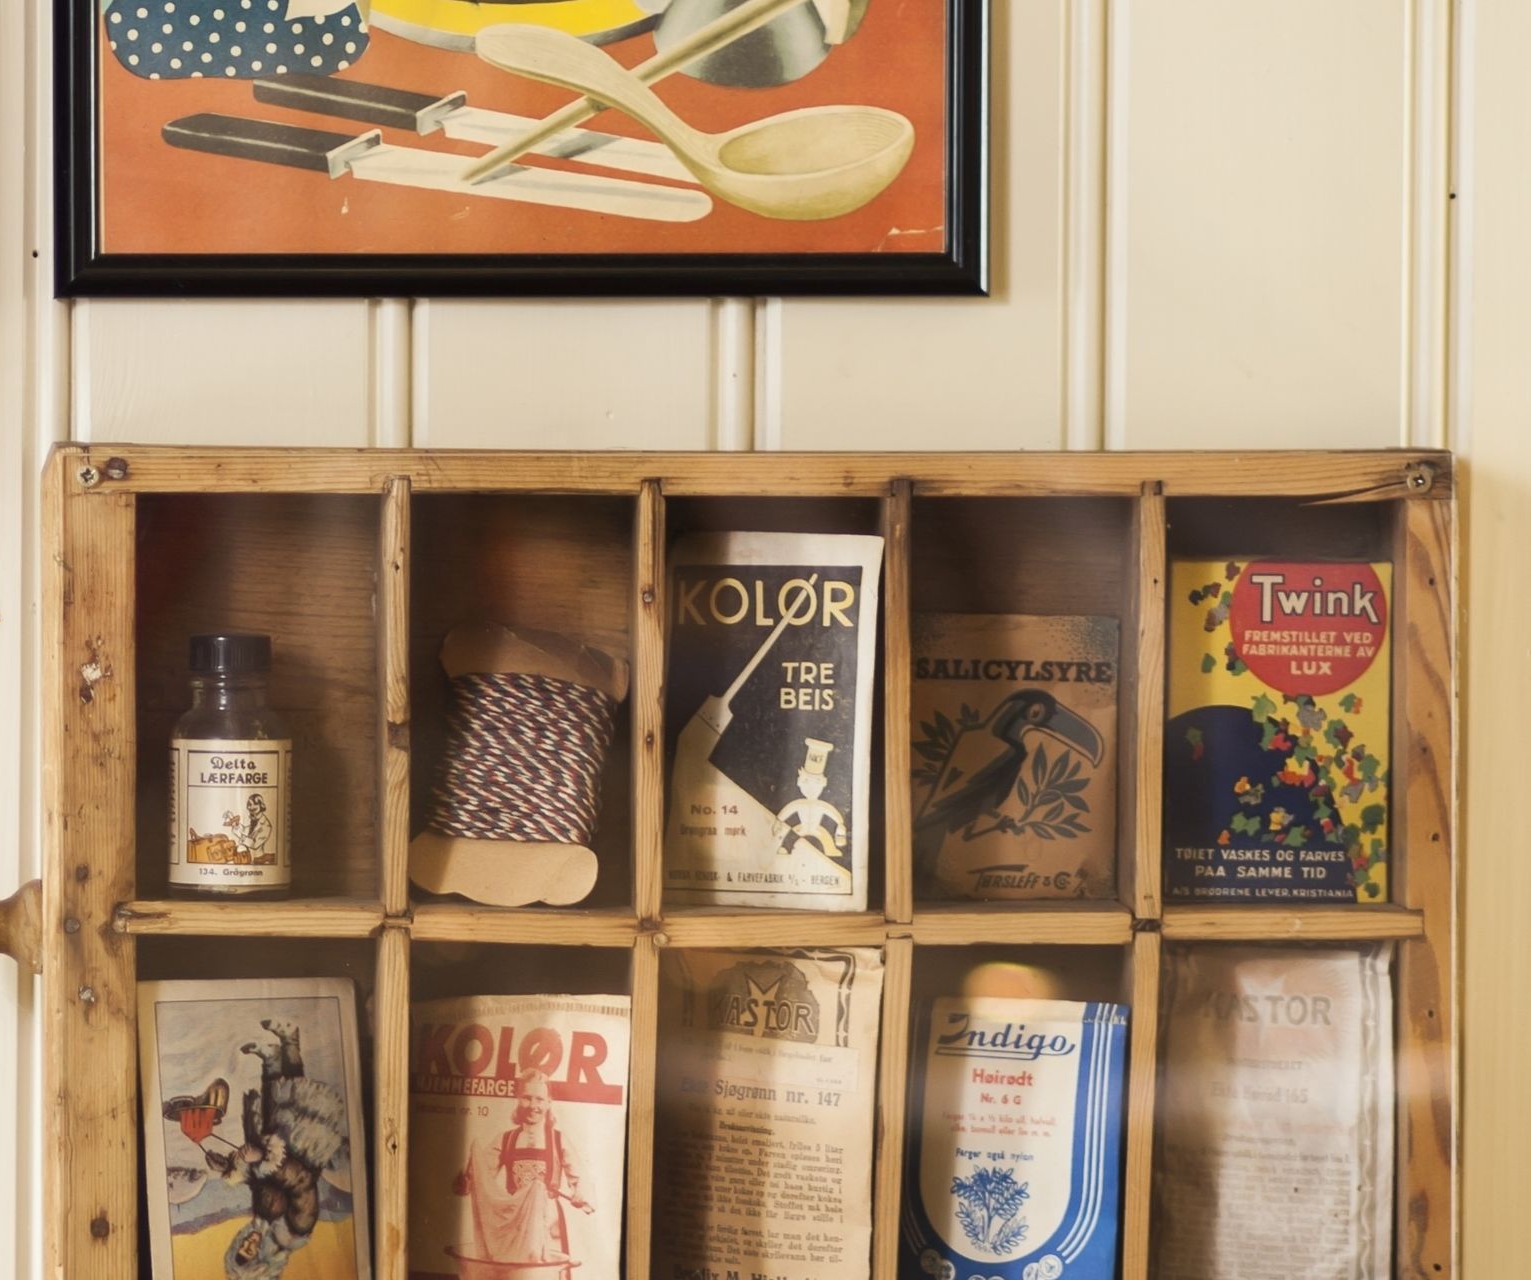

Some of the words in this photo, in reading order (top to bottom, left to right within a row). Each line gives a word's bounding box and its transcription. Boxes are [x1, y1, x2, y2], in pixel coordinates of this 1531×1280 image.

[677, 575, 856, 628] KOLØR
[1249, 573, 1380, 625] Twink
[1243, 630, 1338, 645] FREMSTILLET
[1343, 631, 1373, 644] VED
[1241, 644, 1352, 658] FABRIKANTERNE
[1356, 645, 1375, 658] AV
[780, 661, 835, 686] TRE
[915, 655, 1114, 683] SALICYLSYRE
[1290, 661, 1333, 677] LUX
[779, 687, 835, 711] BEIS
[210, 756, 257, 771] Delta
[200, 772, 268, 785] LÆRFARGE
[690, 804, 717, 816] No.
[721, 804, 740, 816] 14
[1220, 848, 1271, 861] VASKES
[1275, 849, 1295, 861] OG
[1298, 849, 1346, 862] FARVES
[810, 874, 840, 886] BERGEN
[1194, 865, 1227, 878] PAA
[1236, 865, 1294, 879] SAMME
[1301, 866, 1328, 880] TID
[1291, 888, 1354, 898] KRISTIANIA
[937, 1012, 1077, 1060] Indigo
[420, 1023, 609, 1085] KOLØR
[972, 1068, 1035, 1087] Høirødt
[714, 1079, 777, 1102] Sjøgrønn
[786, 1090, 810, 1105] nr.
[817, 1091, 843, 1108] 147
[980, 1093, 997, 1105] Nr.
[1001, 1093, 1010, 1105] 6
[1013, 1095, 1023, 1106] G
